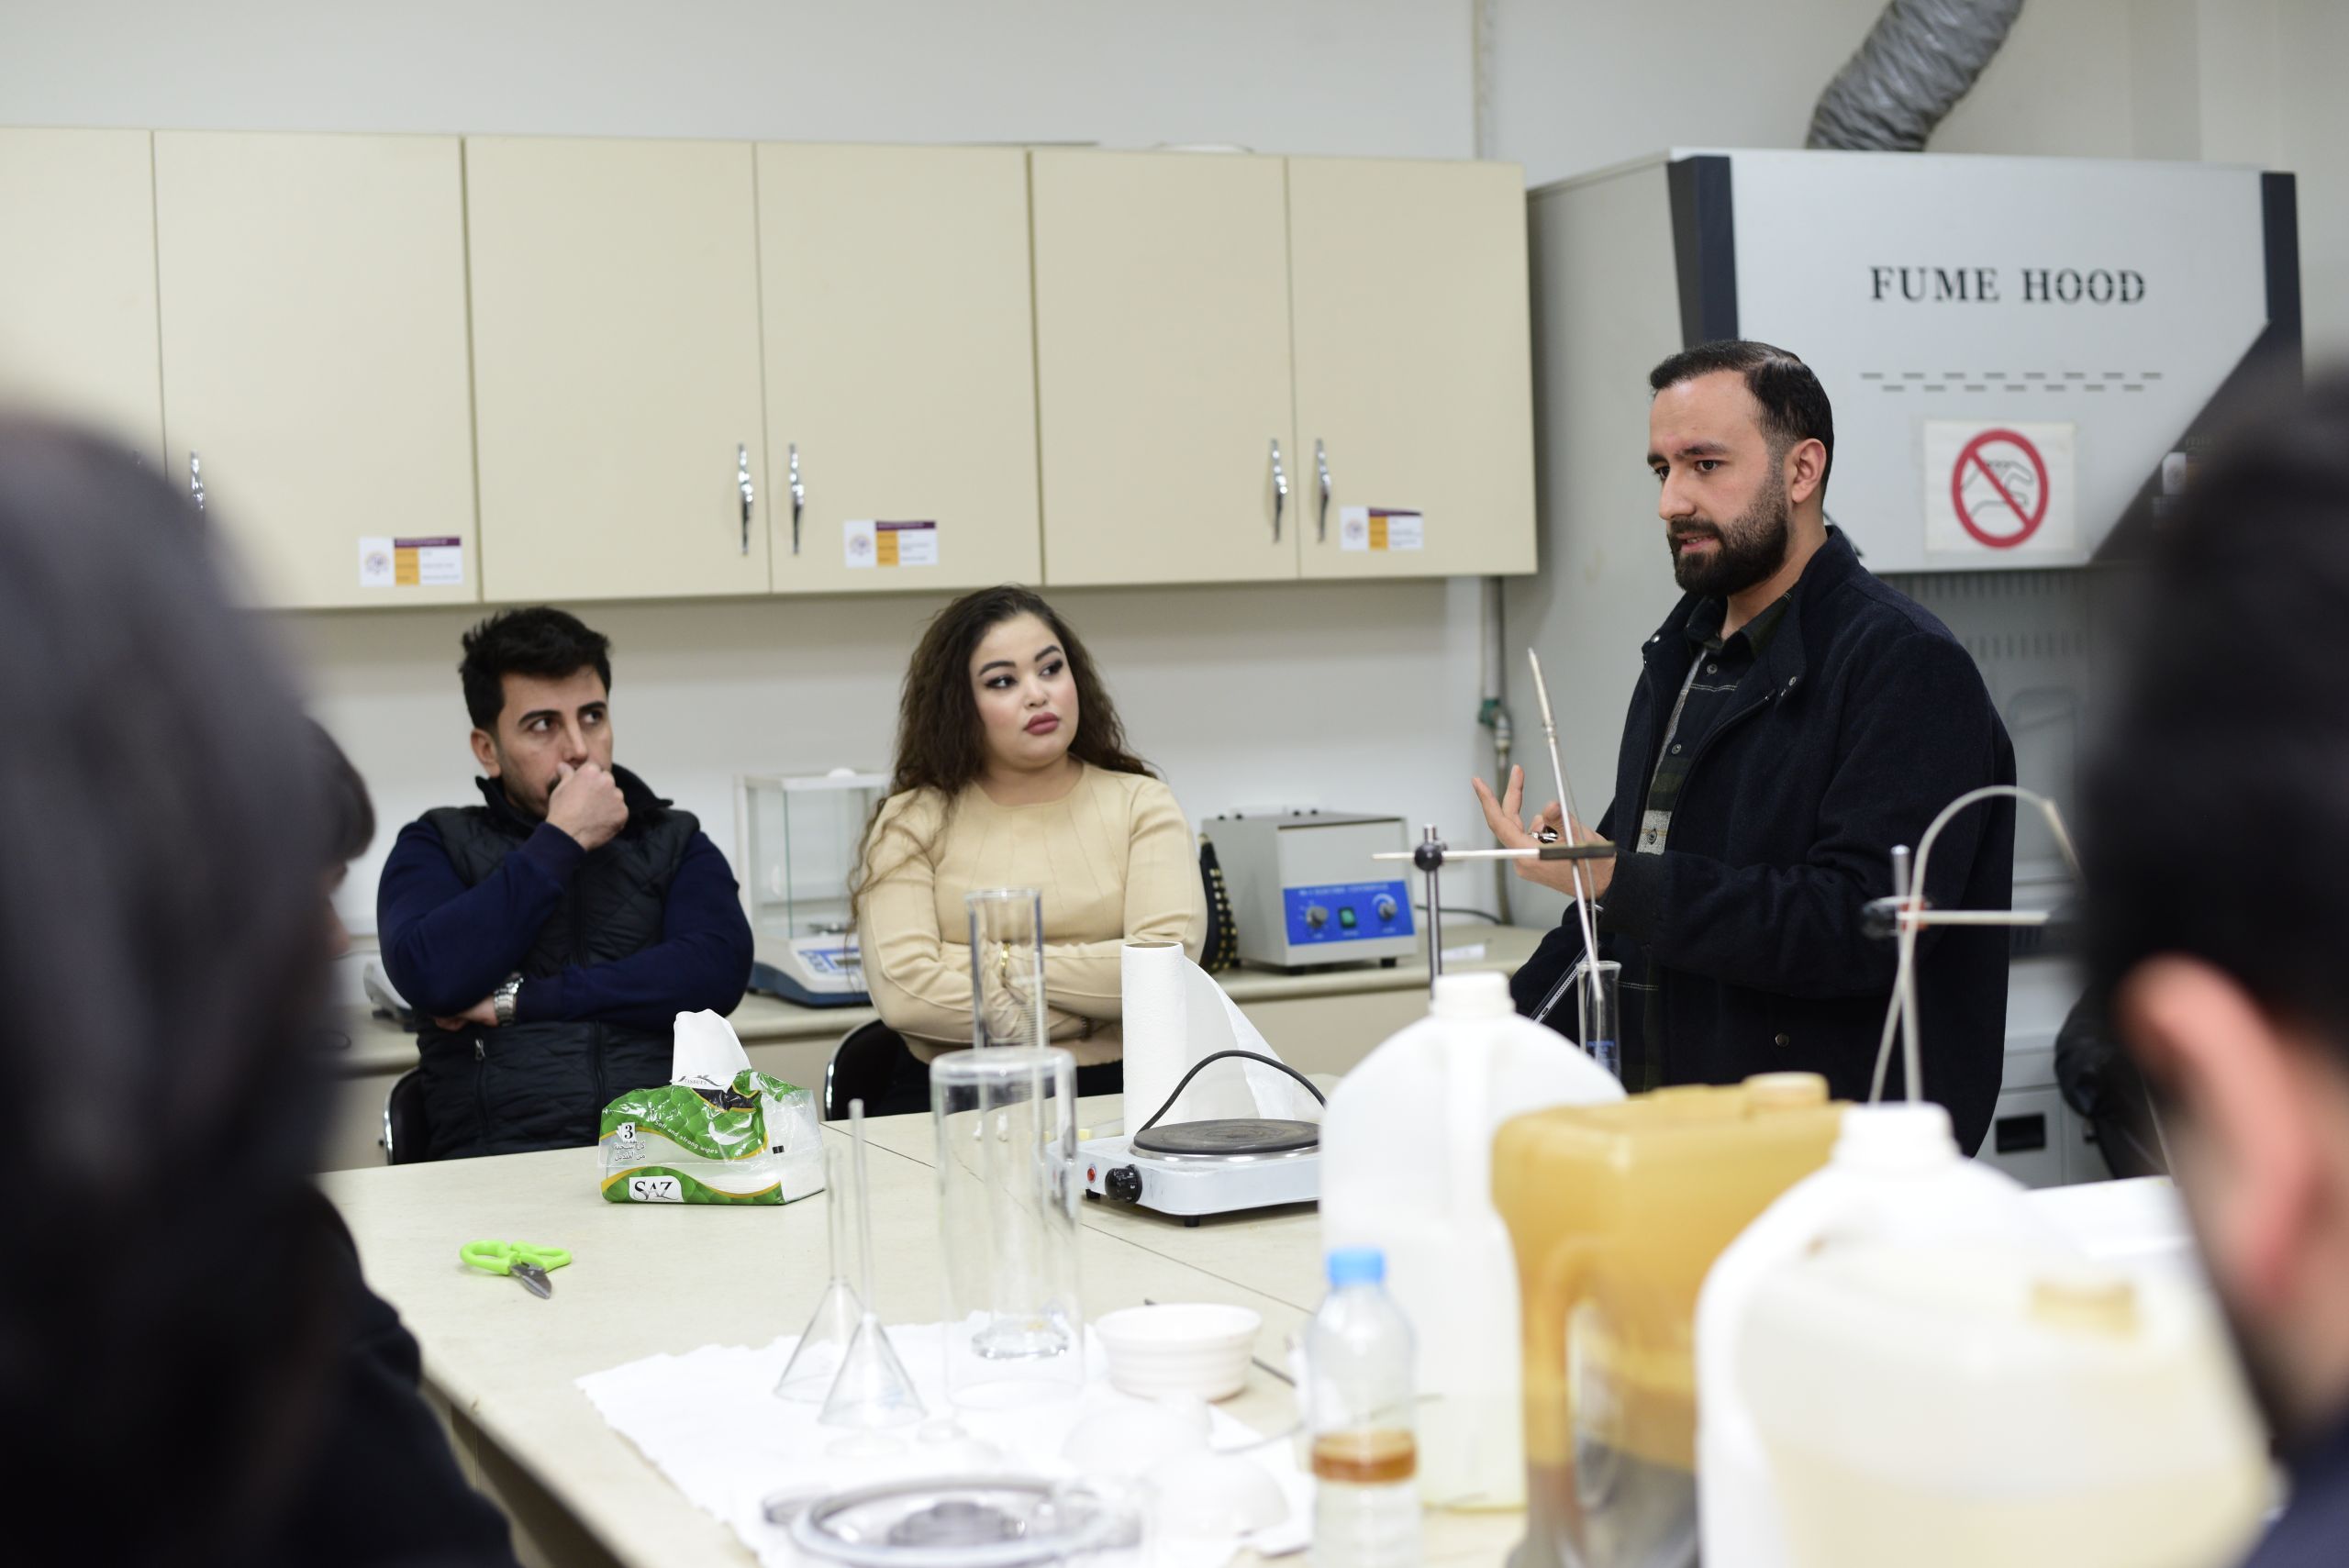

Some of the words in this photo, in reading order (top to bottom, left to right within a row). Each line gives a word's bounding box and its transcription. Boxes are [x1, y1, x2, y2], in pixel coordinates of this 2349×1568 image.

[1870, 266, 2000, 303] FUME
[2021, 268, 2146, 305] HOOD
[624, 1125, 633, 1139] 3
[654, 1119, 667, 1130] Soft
[667, 1129, 679, 1137] and
[680, 1136, 699, 1150] strong
[634, 1180, 674, 1200] SAZ
